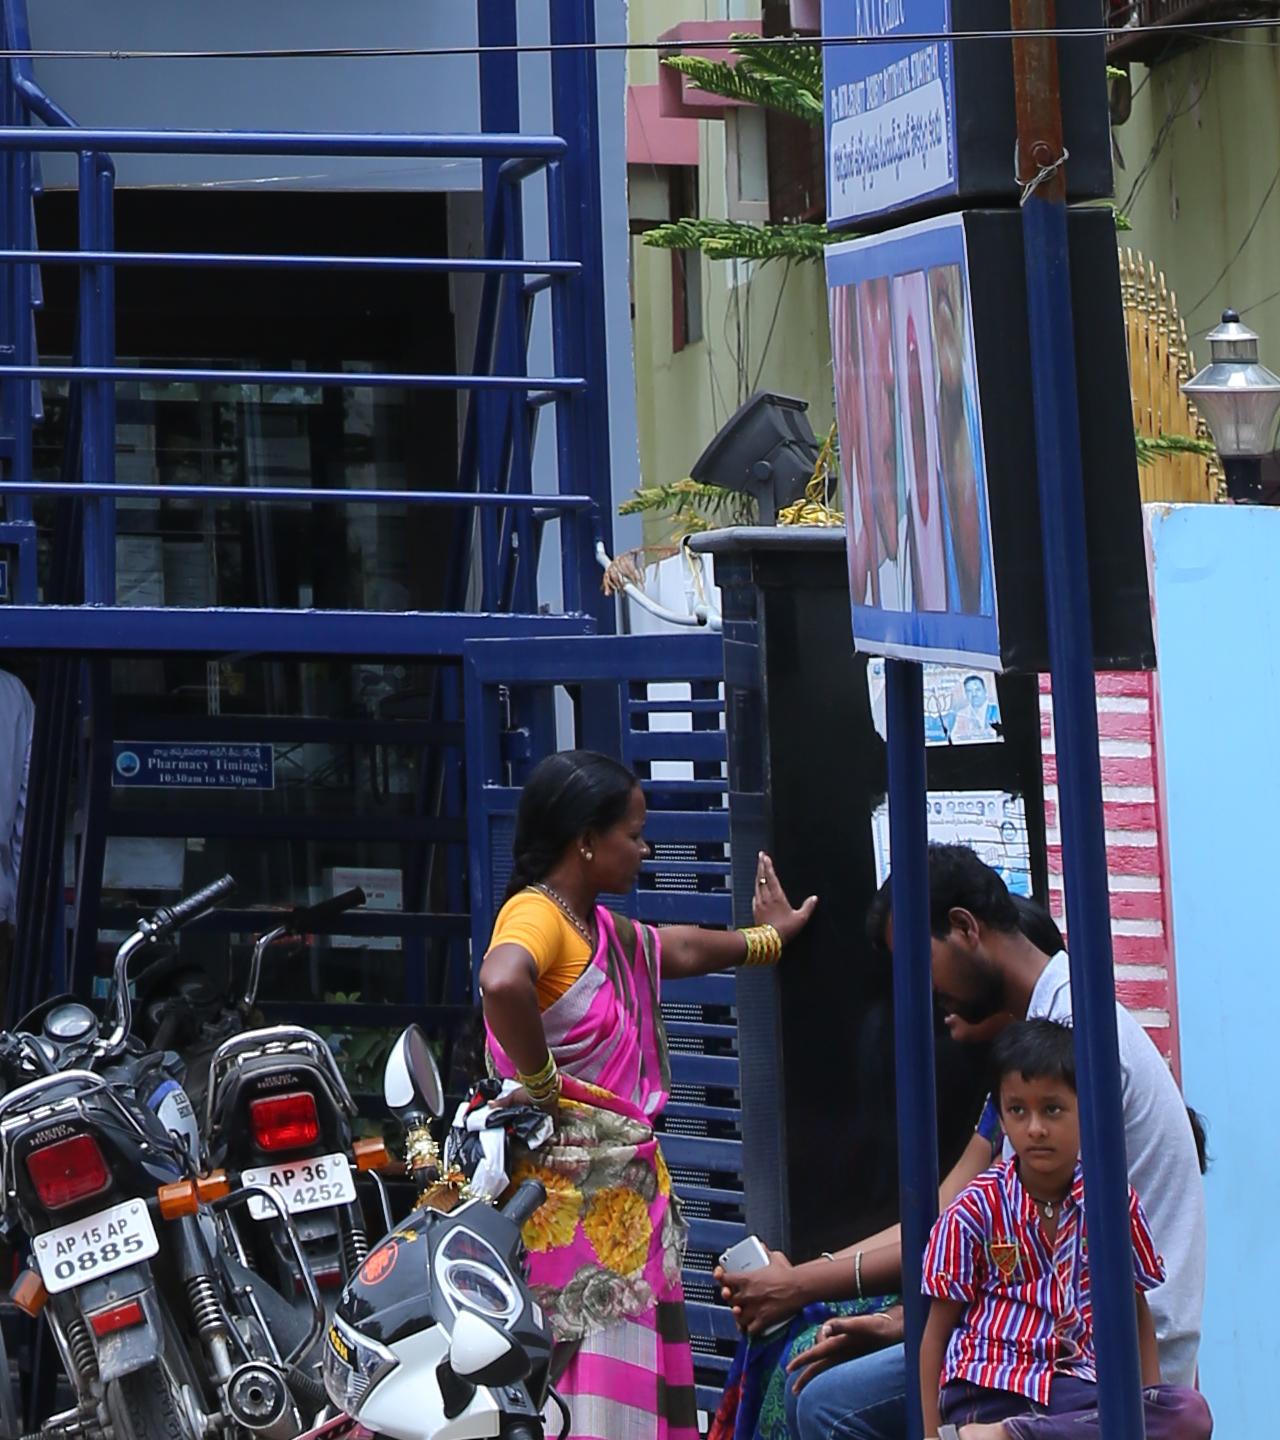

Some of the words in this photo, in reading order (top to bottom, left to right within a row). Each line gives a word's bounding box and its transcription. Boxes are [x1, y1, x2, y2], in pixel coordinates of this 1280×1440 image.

[147, 758, 209, 772] Pharmacy
[269, 1169, 296, 1188] AP
[301, 1163, 328, 1182] 36
[293, 1182, 346, 1206] 4252
[56, 1236, 77, 1258] AP
[81, 1229, 102, 1247] 15
[107, 1218, 128, 1239] AP
[54, 1233, 144, 1280] 0885
